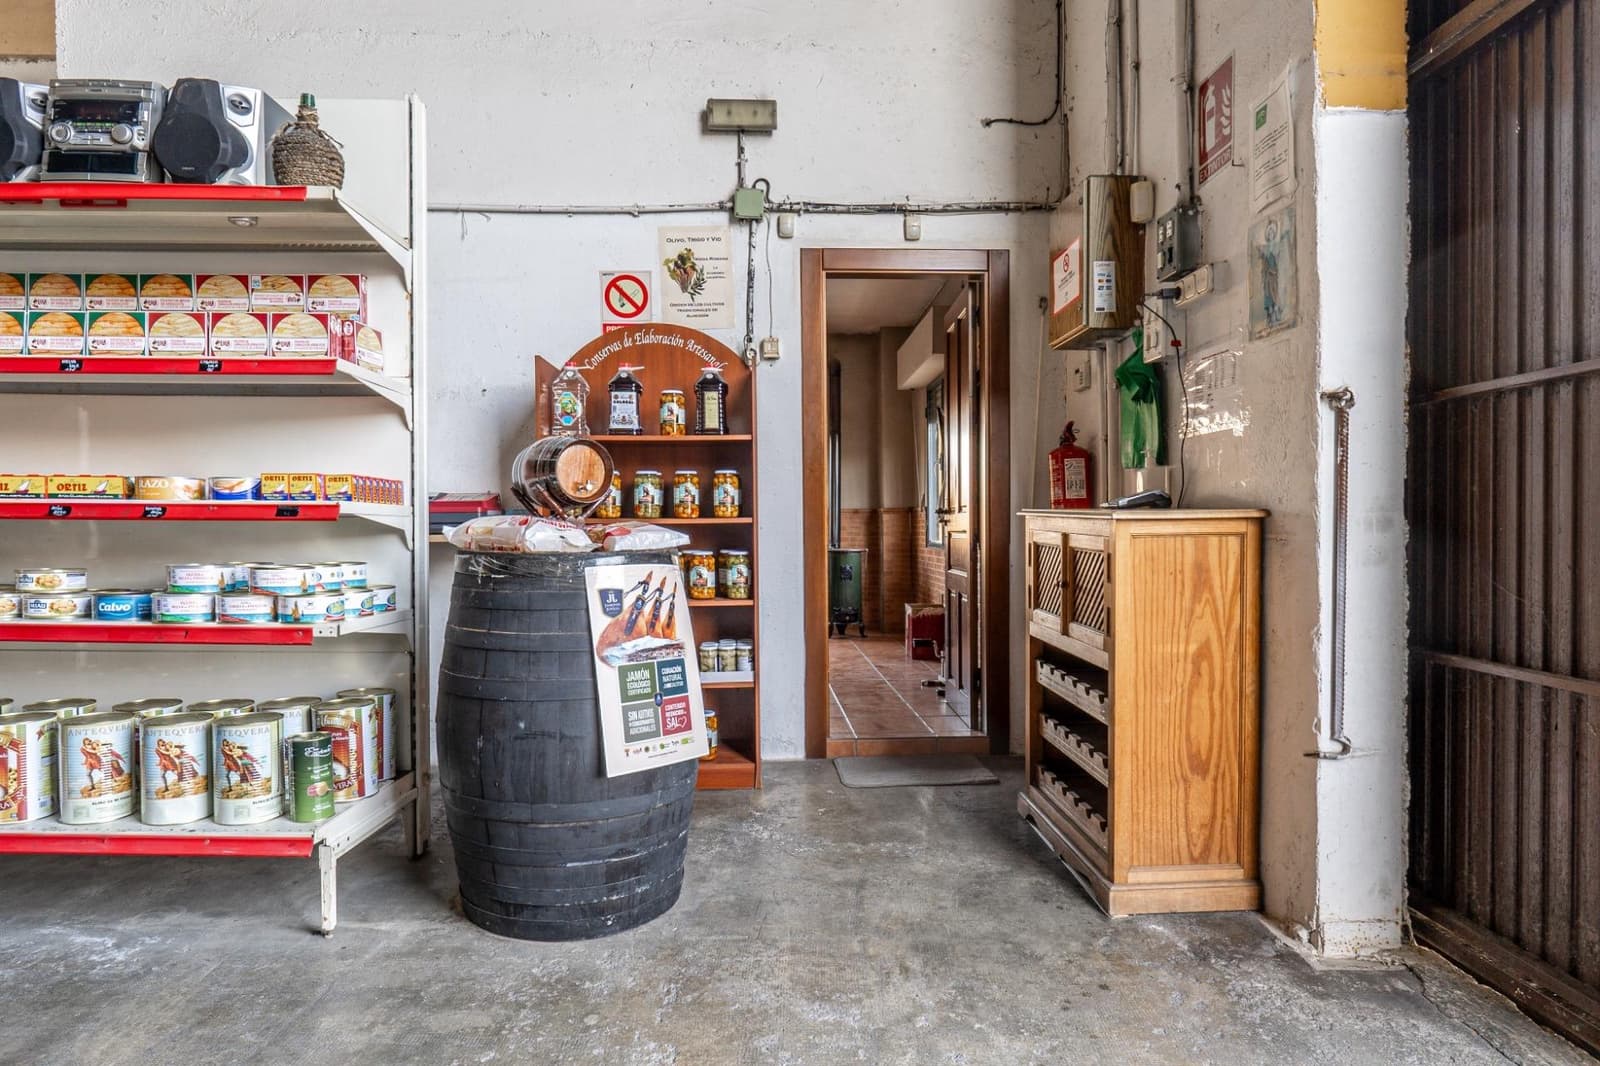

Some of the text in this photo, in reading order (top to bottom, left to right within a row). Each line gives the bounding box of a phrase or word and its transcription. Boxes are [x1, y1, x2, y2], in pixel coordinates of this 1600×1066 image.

[585, 329, 728, 370] Conservas de Elaboración Artesanal
[56, 483, 87, 491] ORTIZ
[98, 602, 132, 612] Calvo
[626, 667, 650, 682] JAMÓN
[666, 717, 679, 729] SAL
